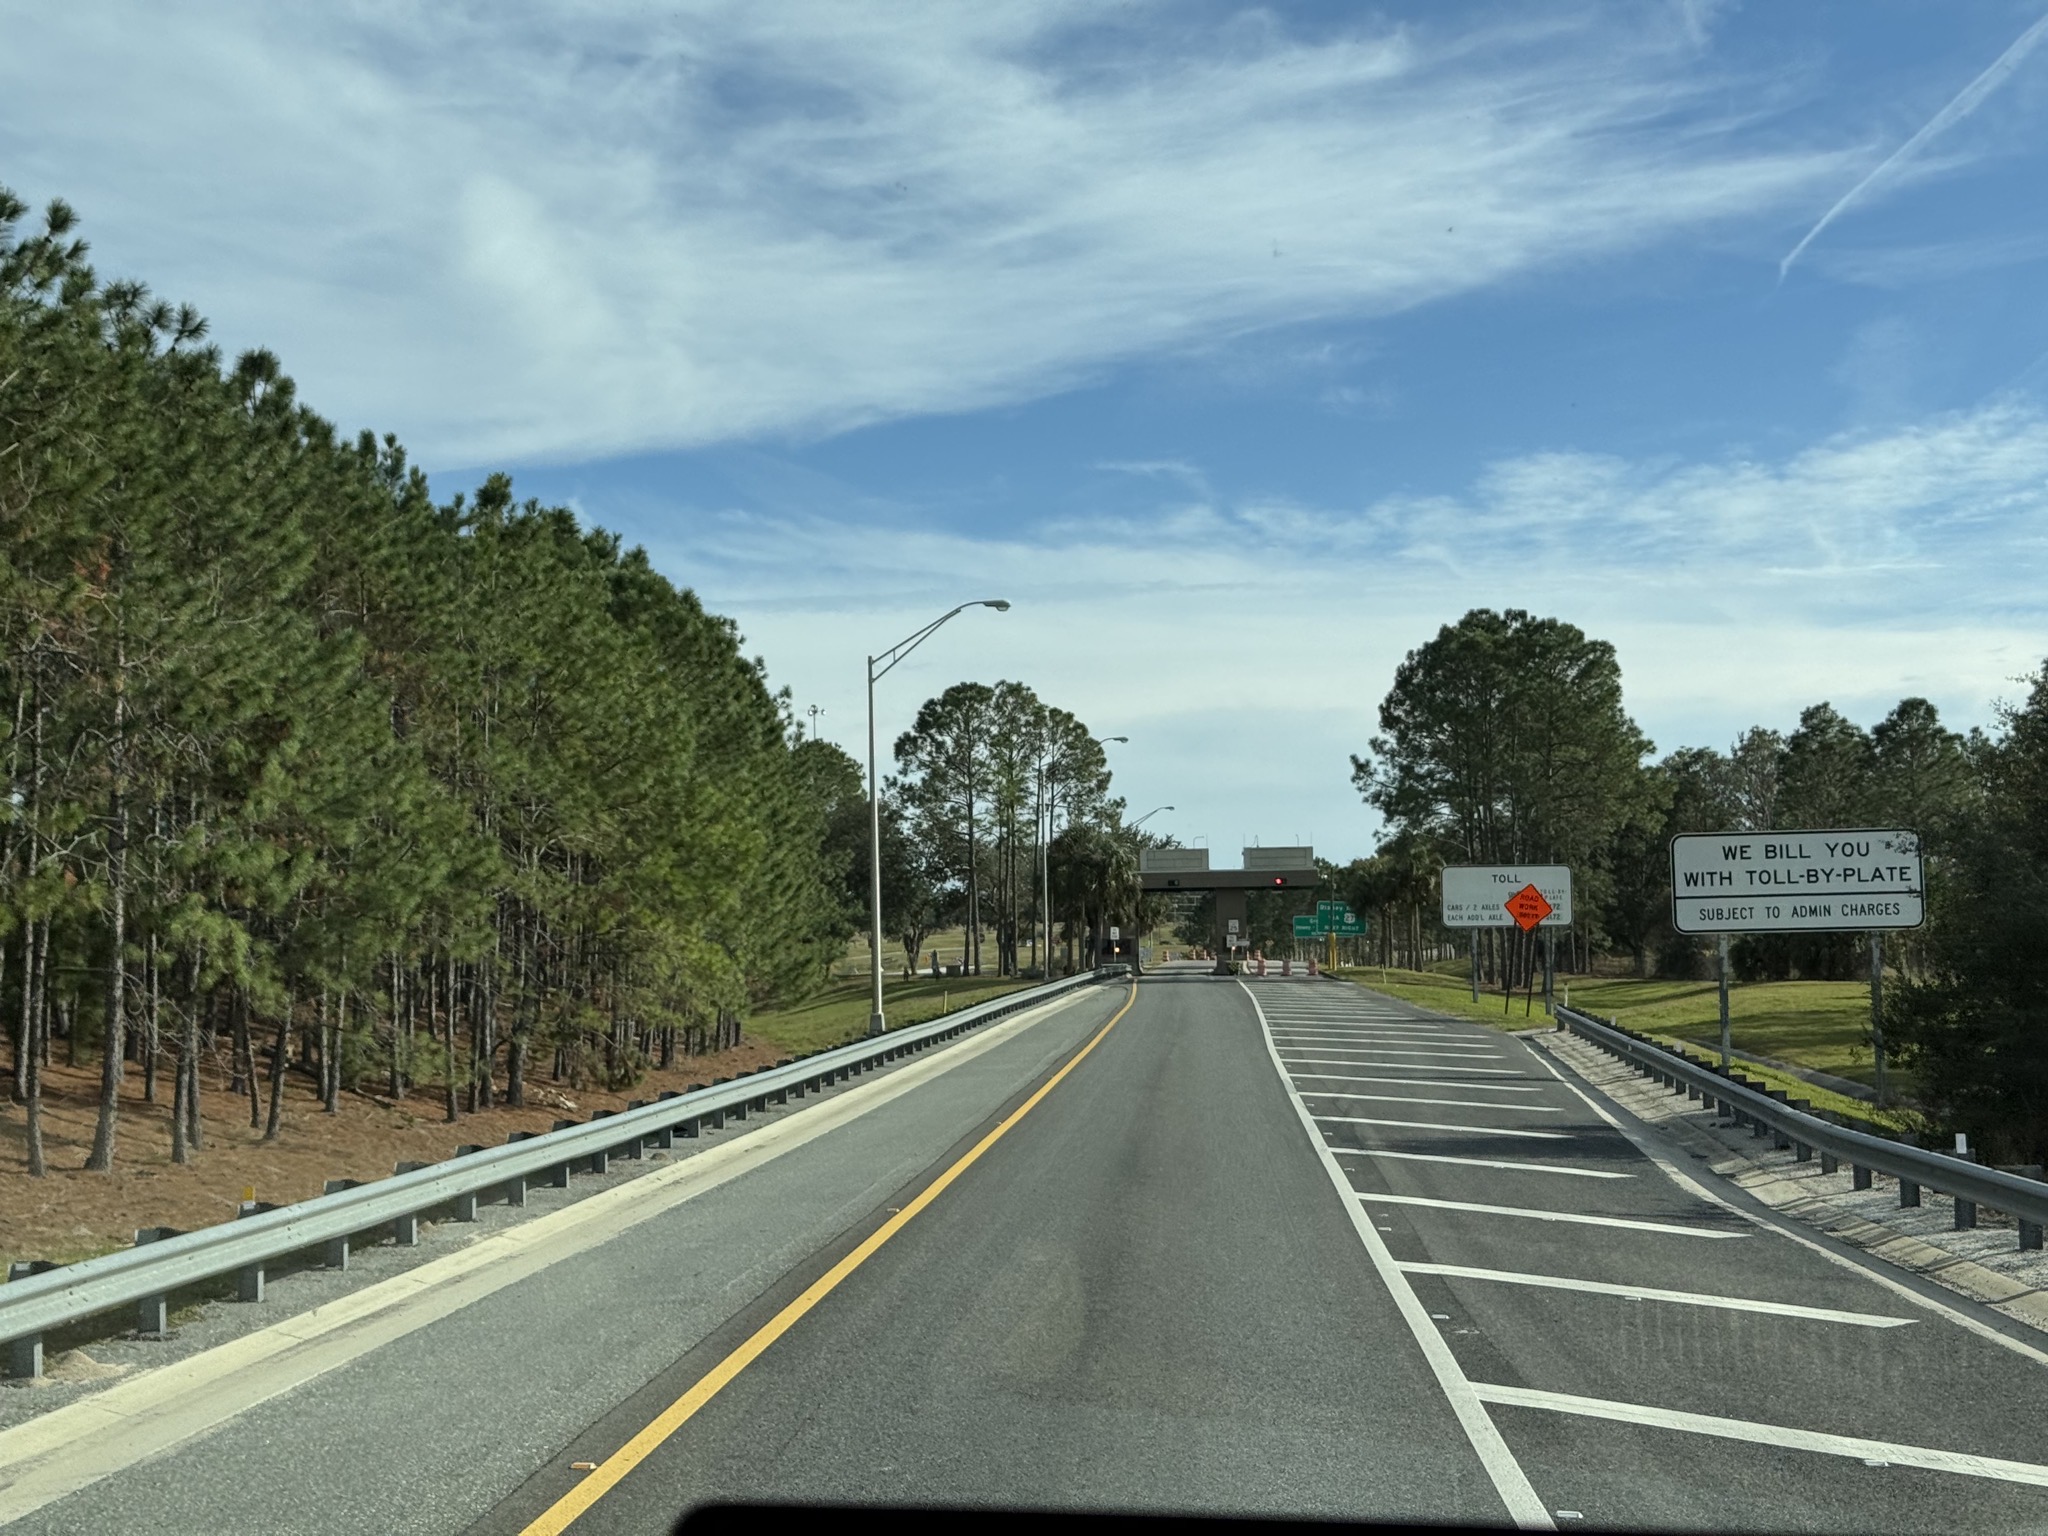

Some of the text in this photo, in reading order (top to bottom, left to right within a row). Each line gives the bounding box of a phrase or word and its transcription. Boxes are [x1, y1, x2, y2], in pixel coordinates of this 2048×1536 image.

[1722, 841, 1870, 861] WE BILL YOU
[1491, 874, 1521, 883] TOLL
[1683, 866, 1912, 887] WITH TOLL-BY-PLATE
[1519, 894, 1539, 902] ROAD
[1320, 904, 1343, 912] Disey
[1481, 903, 1500, 911] AXLES
[1519, 903, 1538, 911] WORK
[1699, 902, 1900, 921] SUBJECT TO ADMIN CHARGES
[1488, 913, 1503, 921] AXLE
